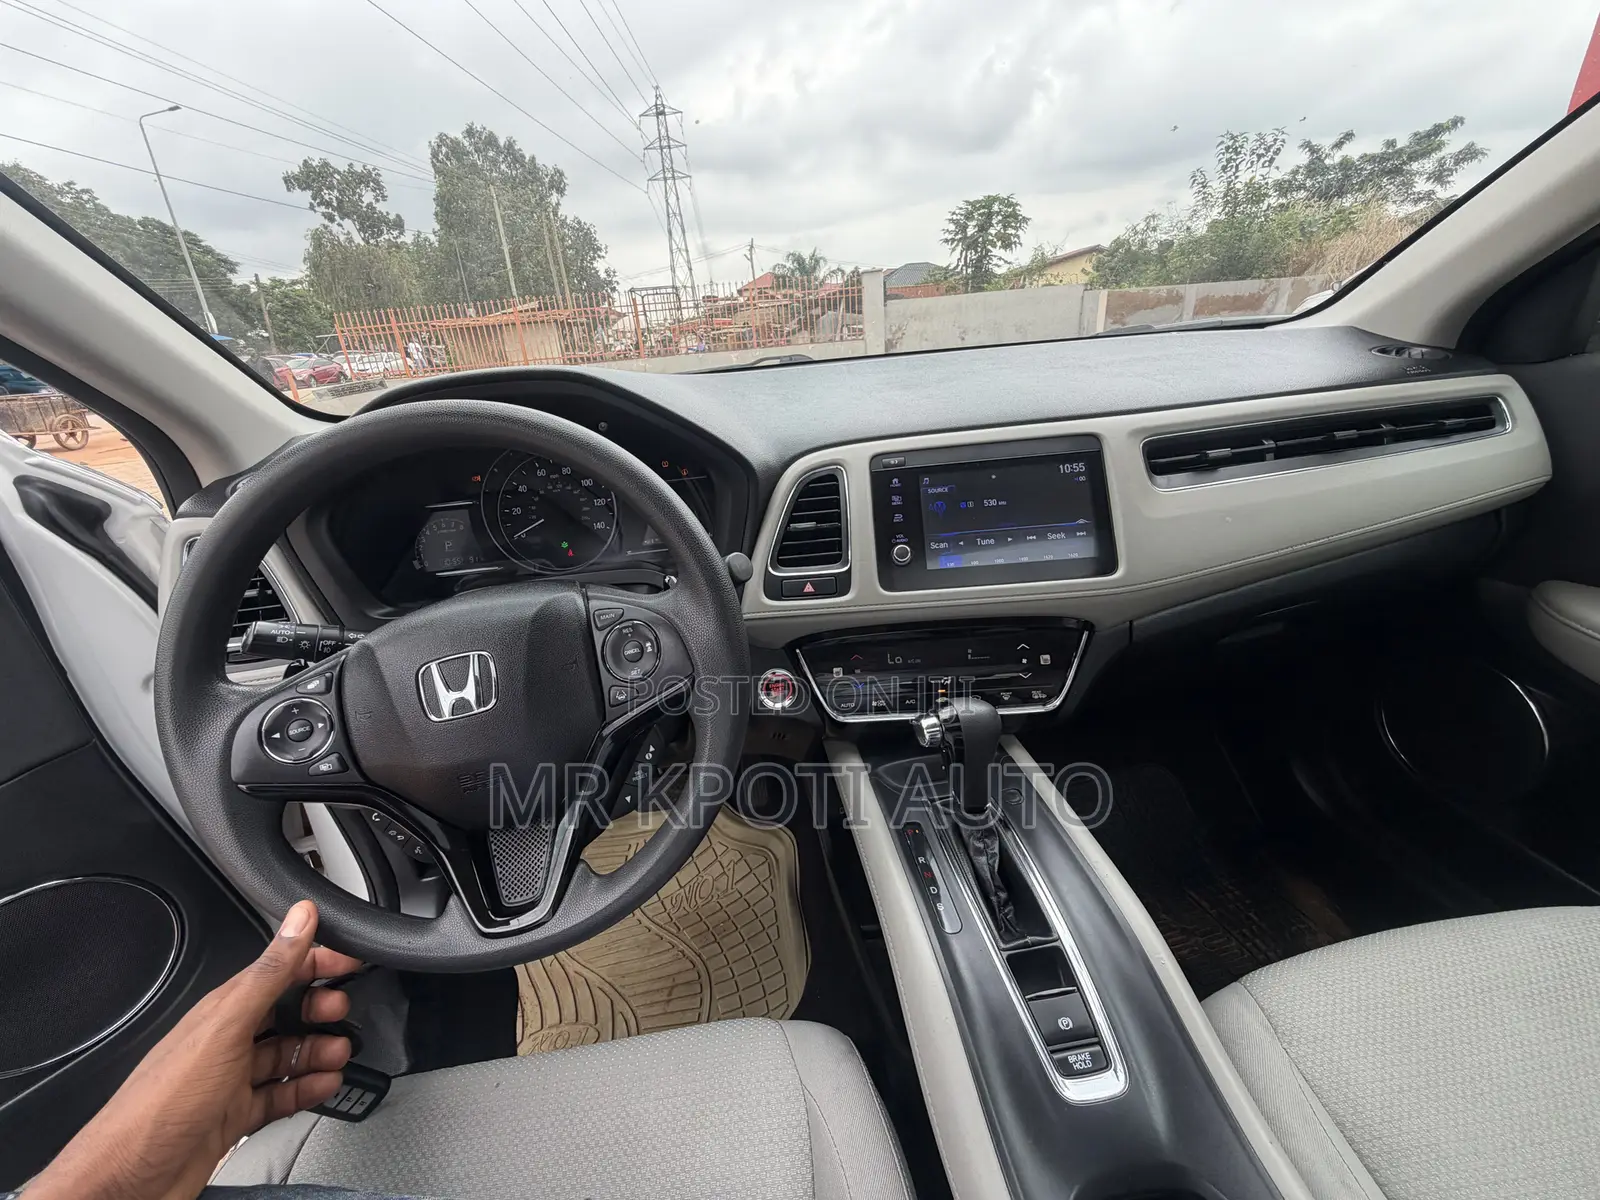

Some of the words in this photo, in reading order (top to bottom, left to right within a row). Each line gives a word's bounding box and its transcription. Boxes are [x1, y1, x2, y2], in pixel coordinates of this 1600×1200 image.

[536, 468, 546, 477] 60
[561, 466, 572, 475] 80
[1059, 462, 1086, 474] 10:55
[581, 478, 594, 487] 100
[518, 484, 528, 493] 40
[927, 486, 949, 494] SOURCE
[593, 498, 606, 506] 120
[983, 499, 998, 507] 530
[511, 507, 522, 515] 20
[593, 521, 606, 530] 140
[930, 541, 949, 550] Scan
[976, 538, 995, 546] Tune
[1047, 532, 1067, 540] Seek
[289, 725, 312, 736] SOURCE
[918, 856, 926, 864] R
[930, 886, 938, 894] D
[936, 902, 945, 911] S
[1067, 1051, 1092, 1064] BRAKE
[1072, 1060, 1093, 1070] HOLD
